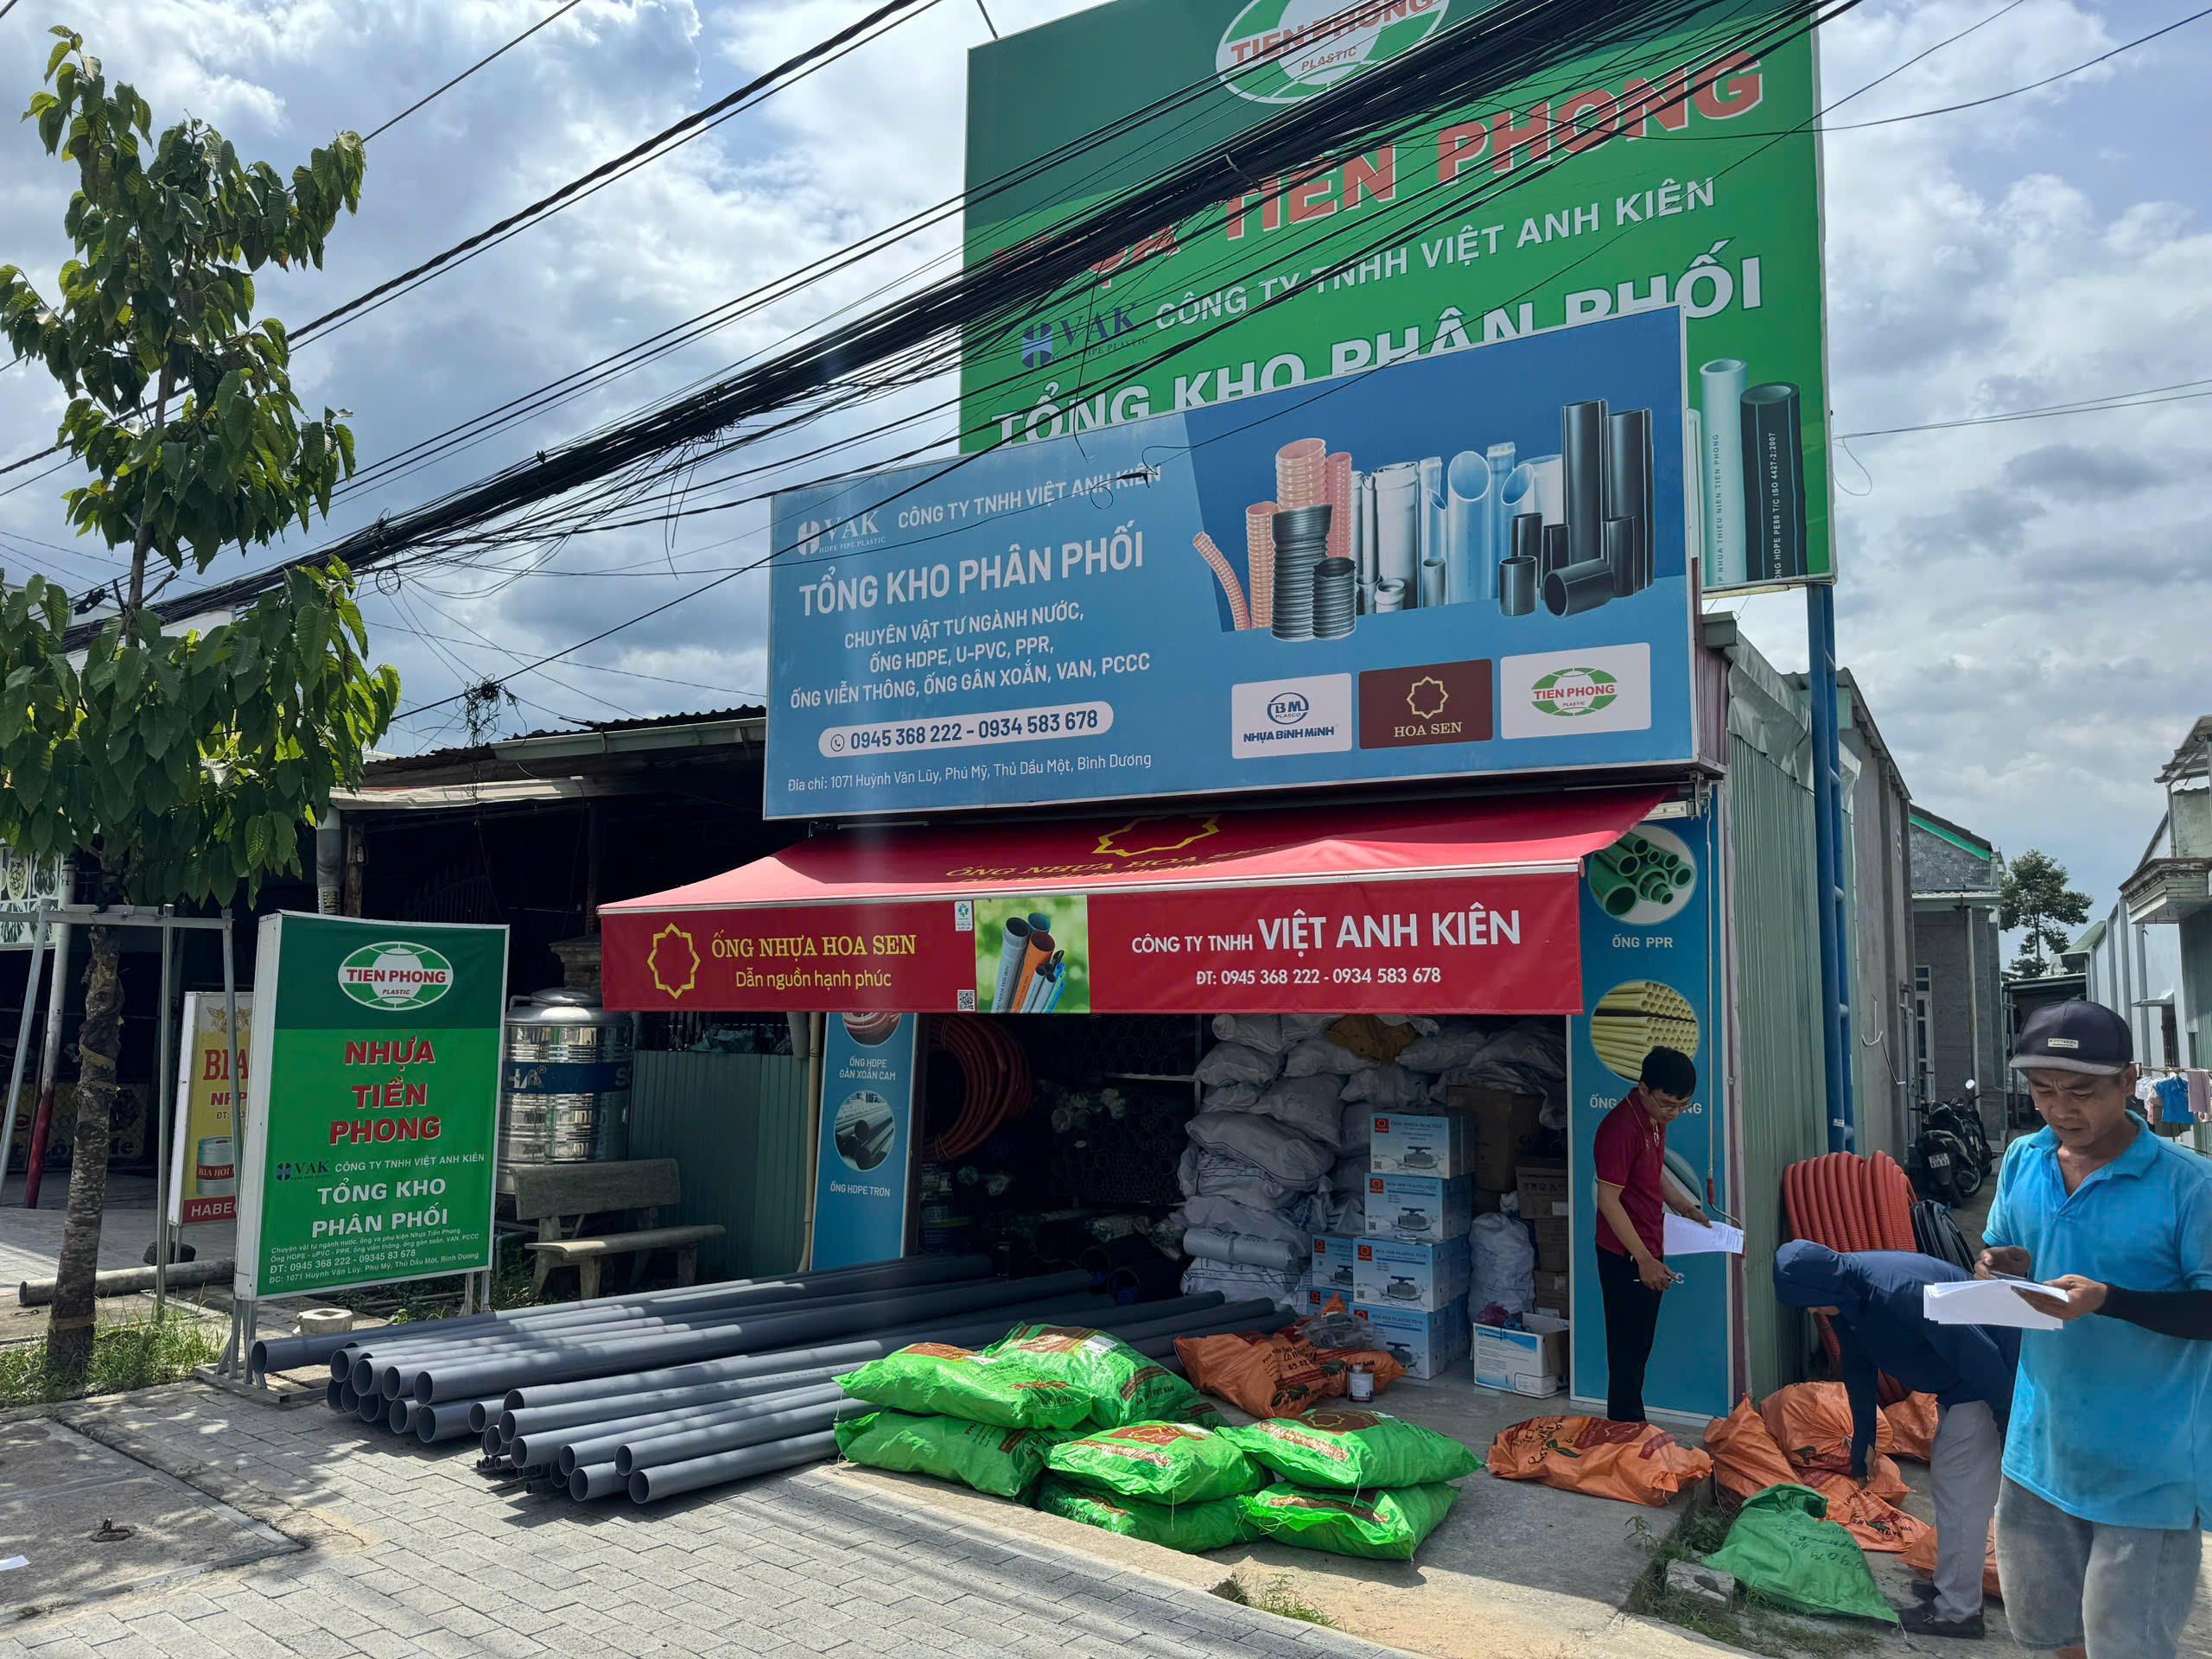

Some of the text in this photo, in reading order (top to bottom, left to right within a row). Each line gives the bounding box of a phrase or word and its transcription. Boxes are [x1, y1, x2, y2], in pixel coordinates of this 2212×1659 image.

[1301, 47, 1357, 71] PLASTIC
[1438, 52, 1763, 184] PHONG
[1155, 285, 1247, 329] CÔNG
[1259, 272, 1301, 303] TY
[1316, 249, 1408, 295] TNHH
[1421, 224, 1504, 267] VIỆT
[1516, 203, 1599, 249] ANH
[1616, 176, 1715, 227] KIÊN
[824, 510, 880, 541] VAK
[899, 505, 944, 528] CÔNG
[948, 500, 969, 518] TY
[974, 491, 1021, 515] TNHH
[1026, 481, 1066, 506] VIỆT
[1071, 473, 1111, 498] ANH
[819, 537, 886, 554] HDPE PIPE PLASTIC
[798, 519, 1143, 616] TỔNG KHO PHÂN PHỐI
[844, 600, 1084, 649] CHUYÊN VẬT TƯ NGÀNH NƯỚC,
[870, 635, 1053, 672] ỐNG HDPE, U-PVC, PPR,
[791, 652, 1151, 709] ỐNG VIỄN THÔNG, ỐNG GÂN XOẮN, VAN, PCCC
[1534, 684, 1615, 700] TIEN PHONG
[850, 709, 1098, 750] 0945 368 222 0934 583 678
[1243, 731, 1274, 743] NHỰA
[1394, 721, 1463, 738] HOA SEN
[831, 774, 853, 789] 1071
[855, 772, 891, 789] Huỳnh
[894, 771, 915, 784] Văn
[945, 766, 968, 781] Phú
[994, 762, 1016, 777] Thủ
[1020, 759, 1043, 774] Dầu
[1046, 758, 1073, 775] Một,
[1109, 753, 1152, 769] Dương
[1131, 901, 1521, 957] CÔNG TY TNHH VIỆT ANH KIÊN
[1611, 933, 1674, 949] ỐNG PPR
[711, 929, 917, 962] ỐNG NHỰA HOA SEN
[346, 969, 446, 983] TIEN PHONG
[736, 967, 892, 990] Dẫn nguồn hạnh phúc
[1196, 967, 1441, 985] ĐT: 0945 368 222 0934 583 678
[345, 1035, 436, 1071] NHỰA
[866, 1058, 887, 1068] HDPE
[879, 1071, 896, 1081] CAM
[351, 1076, 428, 1109] TIỀN
[329, 1116, 442, 1146] PHONG
[295, 1160, 329, 1175] VAK
[334, 1160, 365, 1173] CÔNG
[369, 1160, 381, 1170] TY
[385, 1158, 411, 1168] TNHH
[439, 1154, 460, 1165] ANH
[317, 1176, 447, 1205] TỔNG KHO
[311, 1202, 448, 1239] PHÂN PHỐI
[270, 1249, 416, 1274] ĐT: 0945 368 222 09345 83 678
[286, 1253, 306, 1262] HDPE
